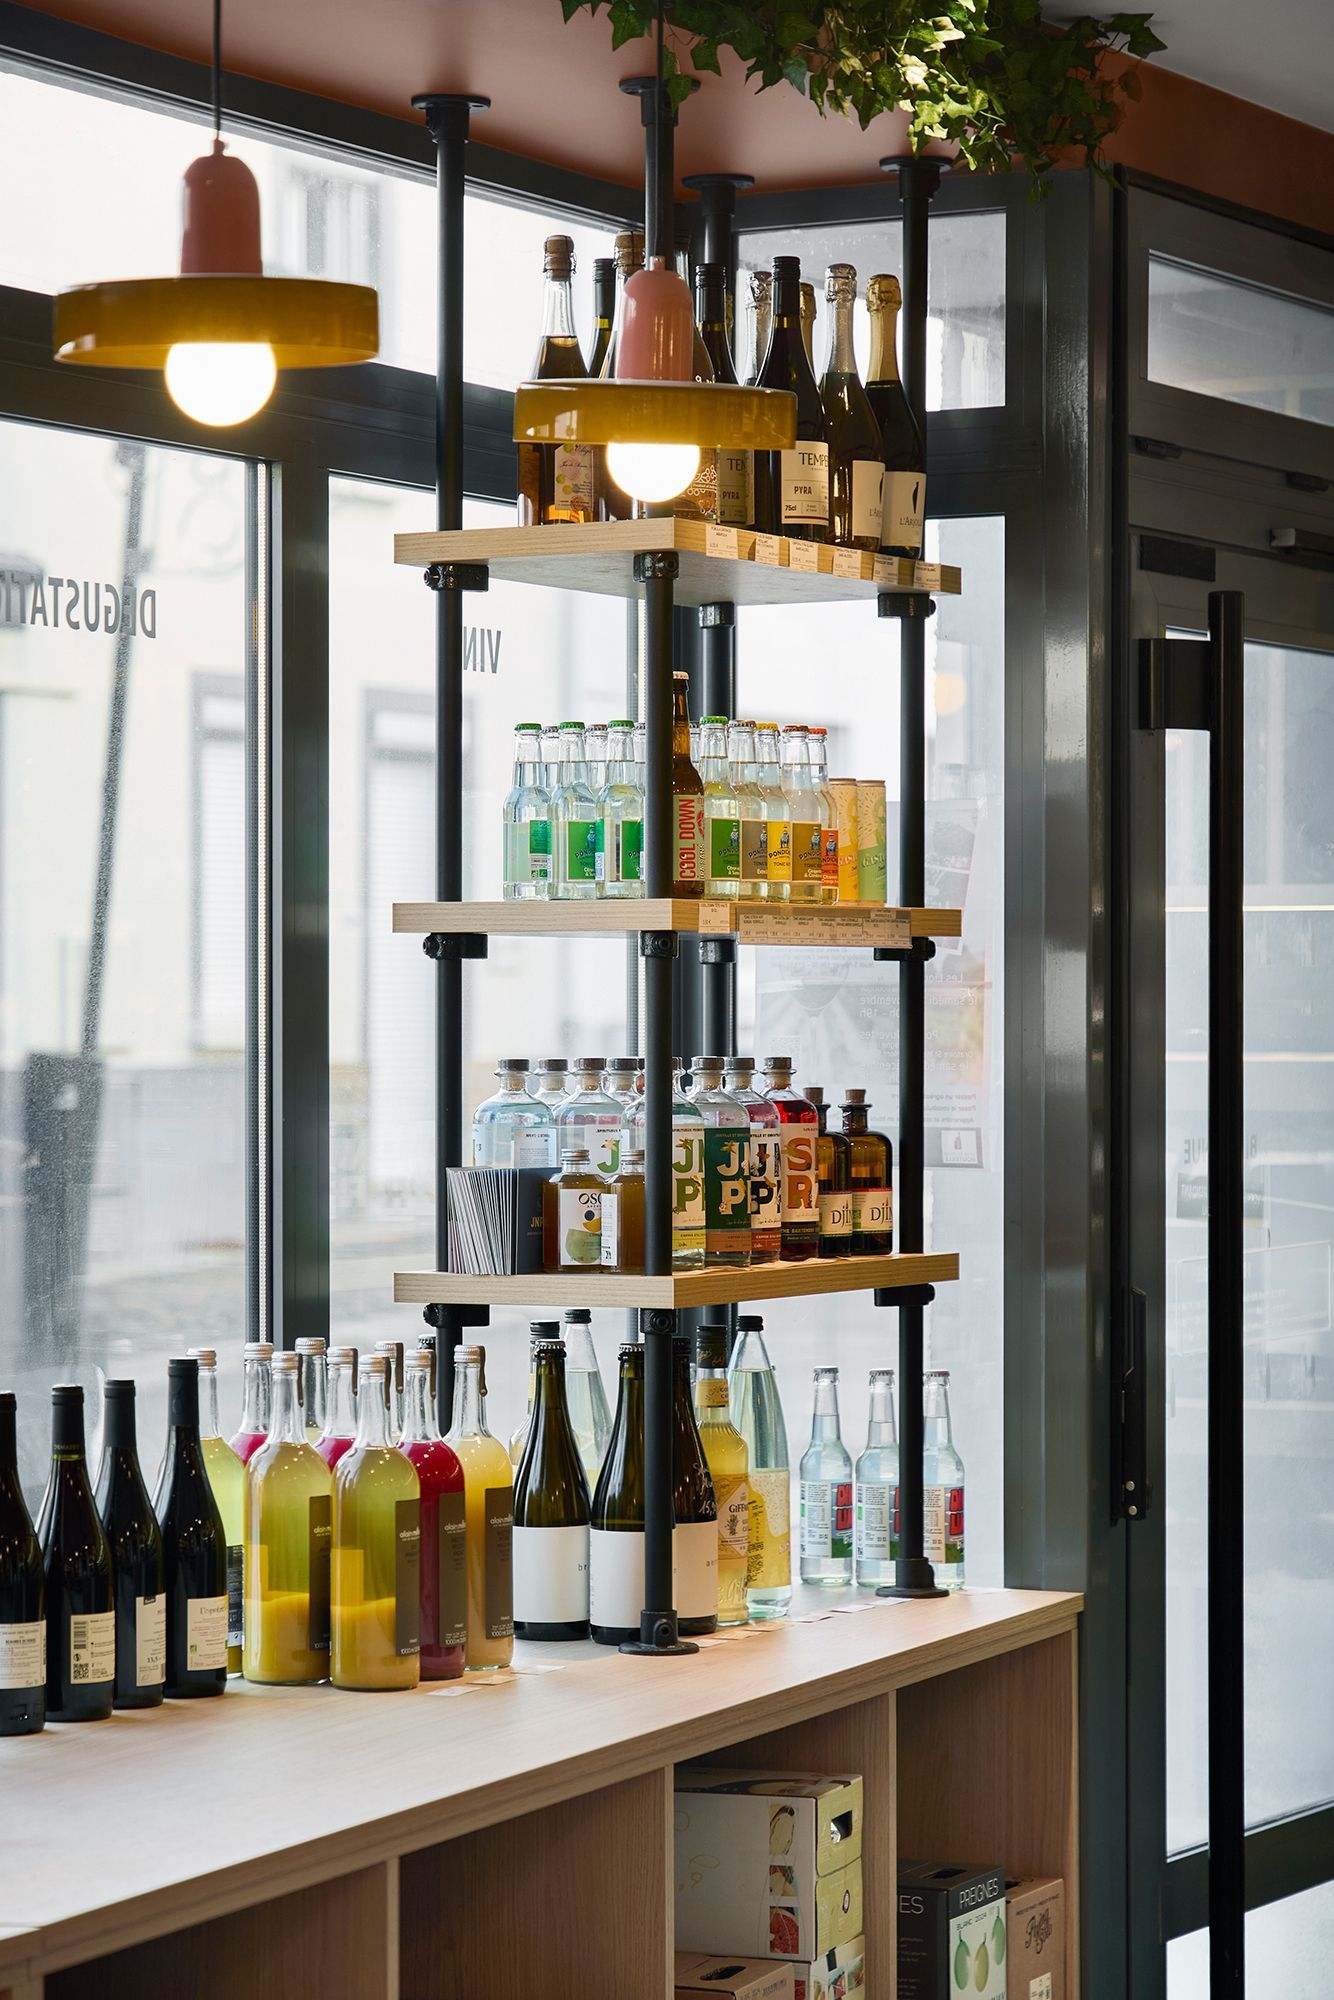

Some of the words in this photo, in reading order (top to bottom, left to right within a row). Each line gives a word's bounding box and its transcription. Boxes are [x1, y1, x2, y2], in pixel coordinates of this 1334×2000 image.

[722, 491, 740, 500] PYRA
[794, 486, 813, 495] PYRA
[679, 799, 695, 840] DOWN
[679, 843, 696, 879] COOL
[959, 1877, 999, 1909] PREIGNES
